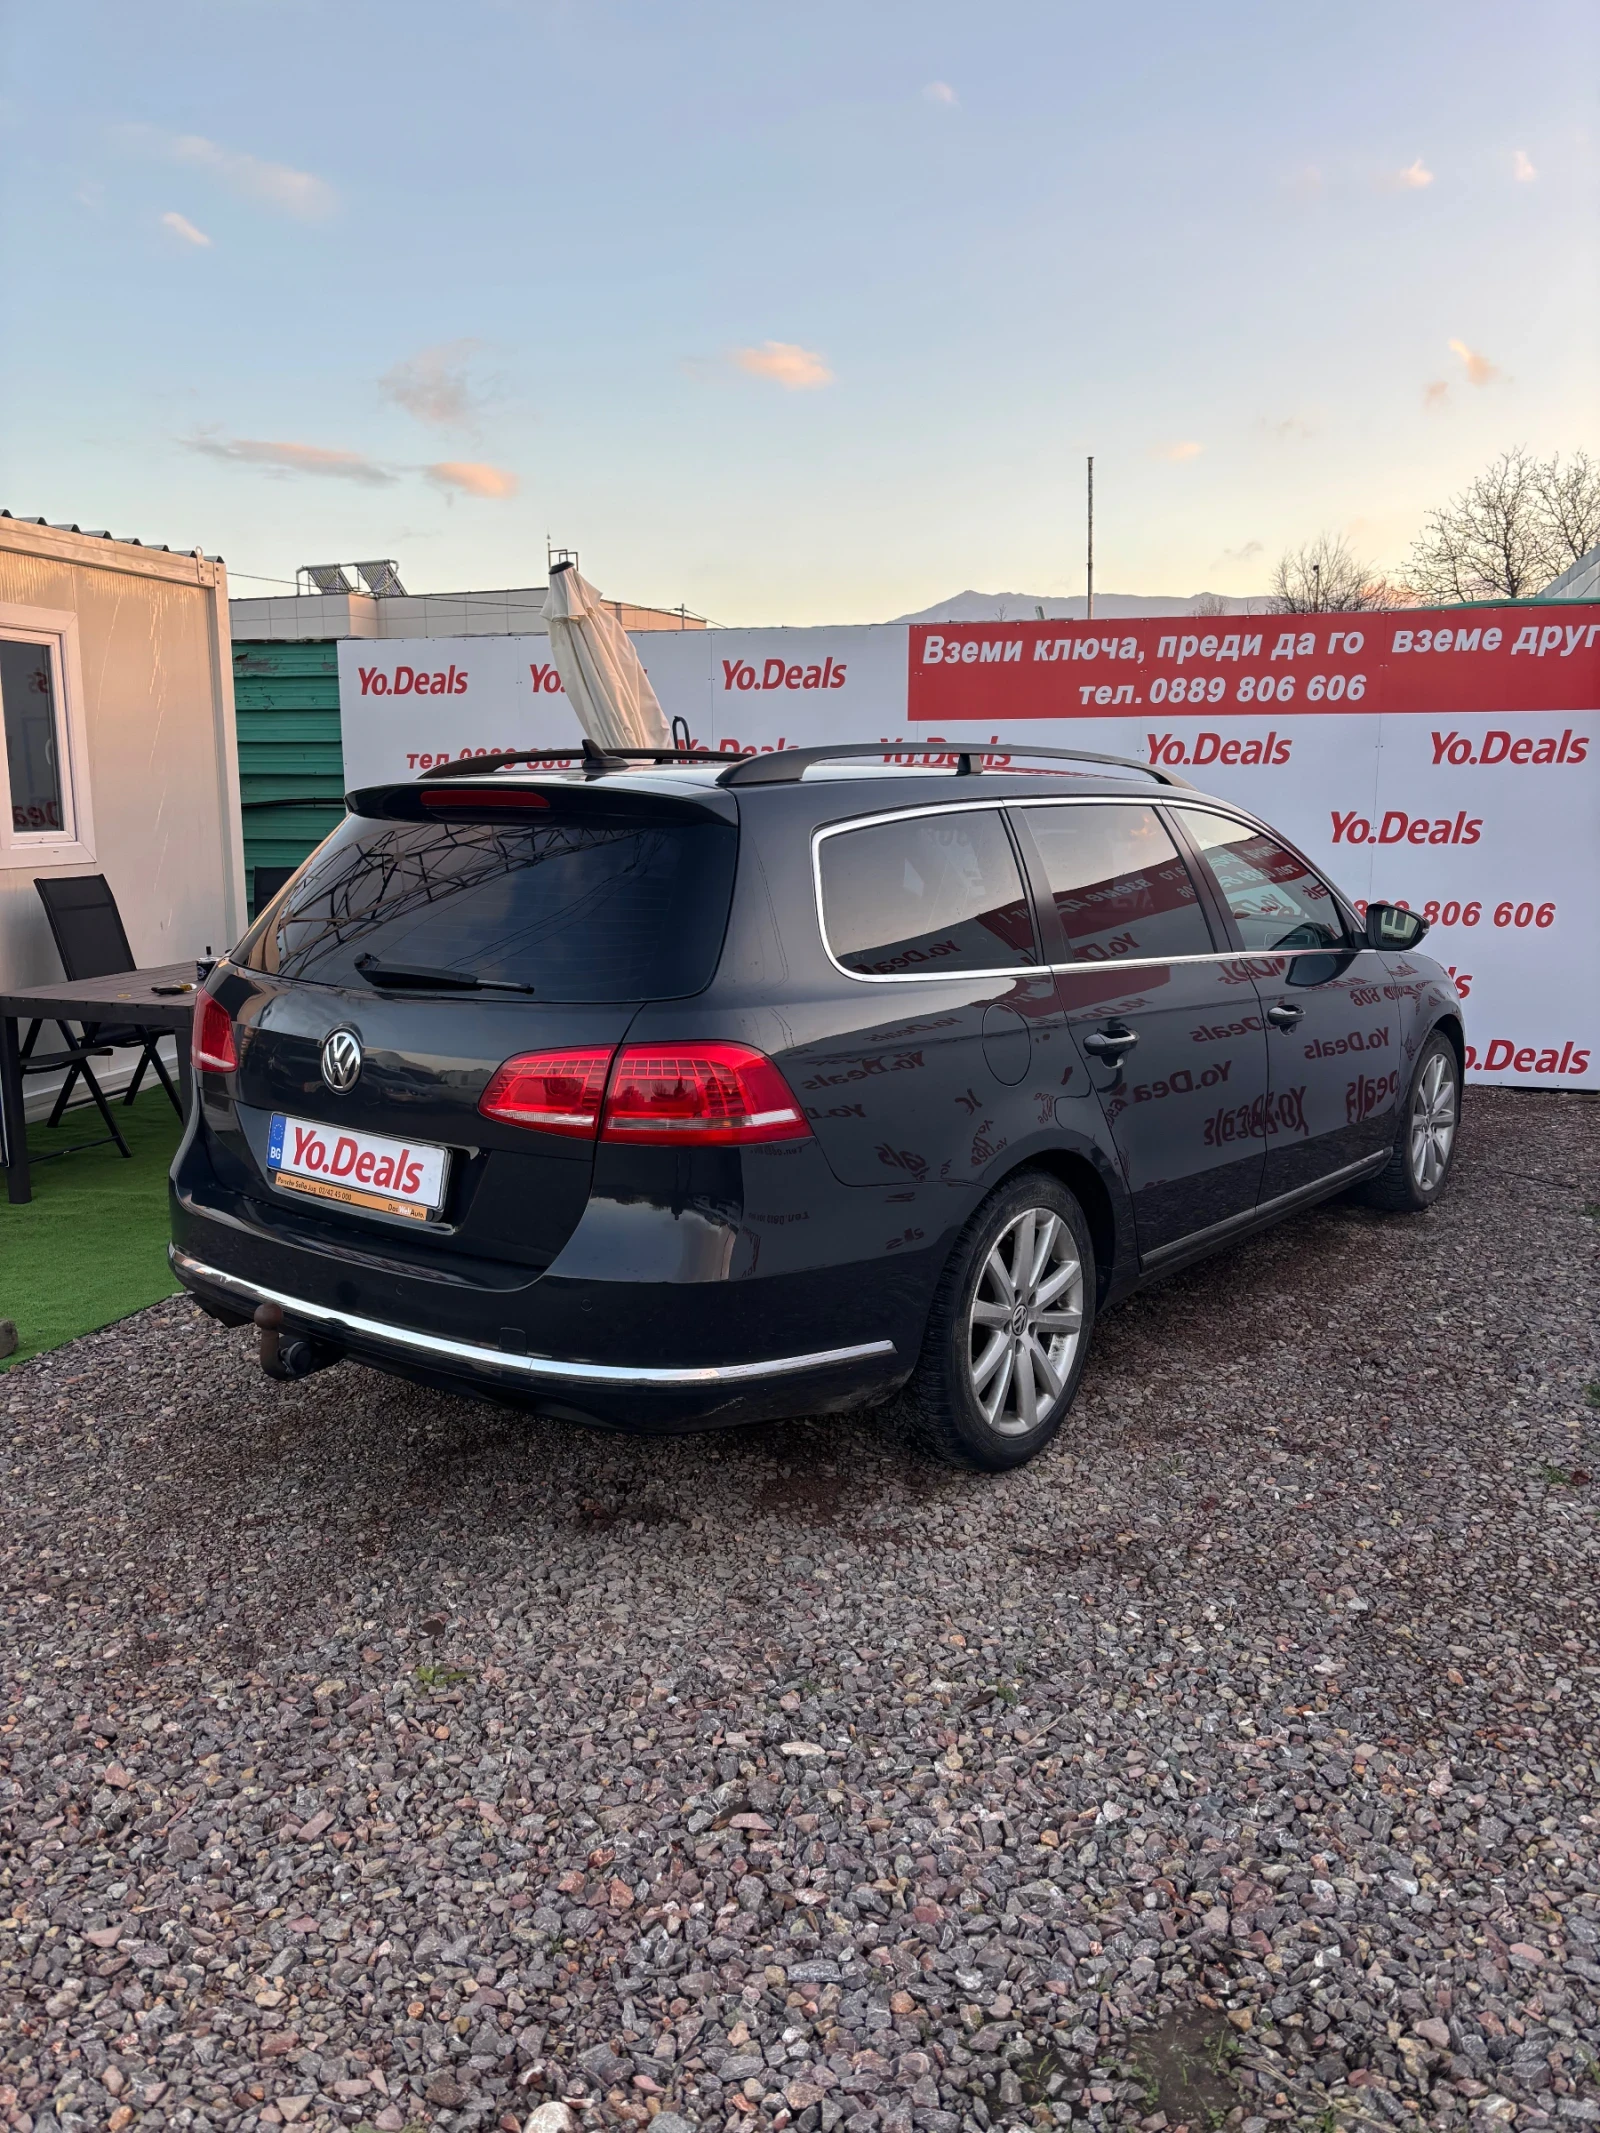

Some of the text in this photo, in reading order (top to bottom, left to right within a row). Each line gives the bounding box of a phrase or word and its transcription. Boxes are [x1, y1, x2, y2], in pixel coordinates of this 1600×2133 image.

[922, 624, 1600, 665] Вземи ключа, преди да го вземе друг
[358, 664, 469, 696] Yo.Deals
[722, 656, 847, 691] Yo.Deals
[1079, 674, 1367, 705] тел. 0889 806 606
[1147, 731, 1292, 766] Yo.Deals
[1431, 729, 1590, 765] Yo.Deals
[1330, 811, 1483, 845] Yo.Deals
[1423, 900, 1482, 927] 806
[1493, 902, 1556, 928] 606
[270, 1146, 281, 1160] BG
[292, 1126, 425, 1194] Yo.Deals
